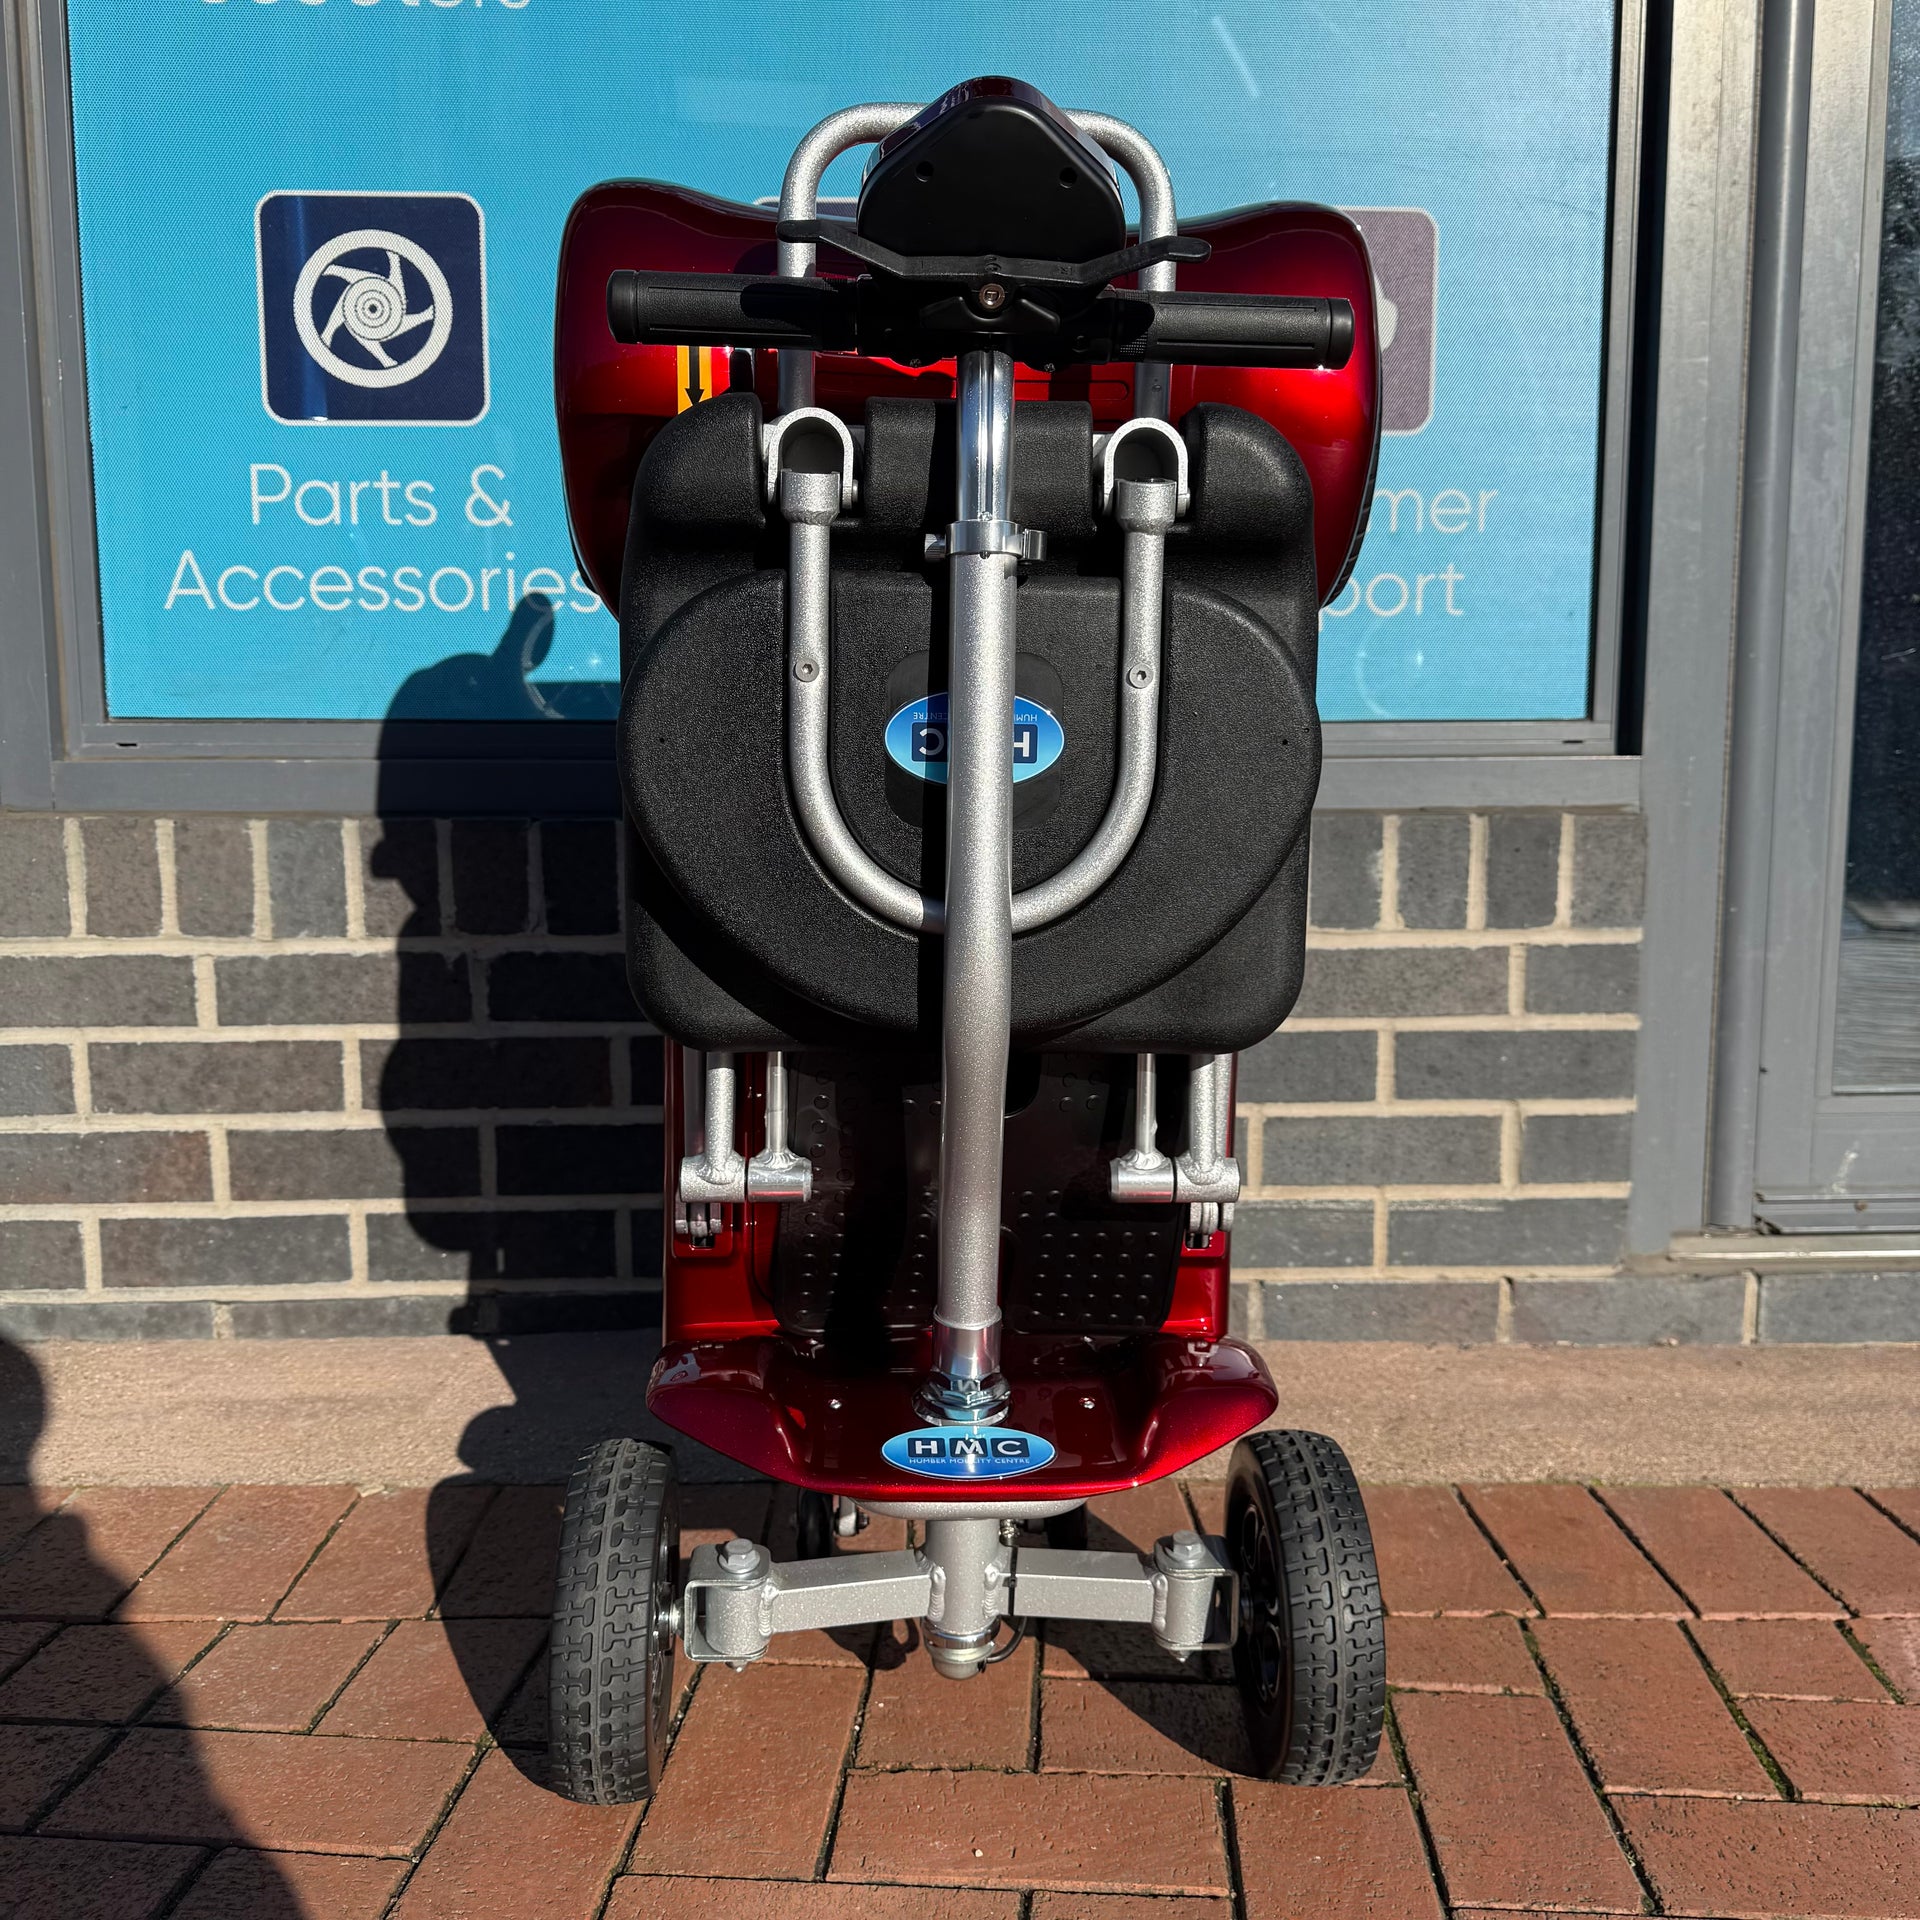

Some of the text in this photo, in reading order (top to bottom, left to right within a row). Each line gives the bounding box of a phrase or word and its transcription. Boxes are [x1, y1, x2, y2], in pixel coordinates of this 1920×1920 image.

[250, 464, 514, 527] Parts &
[1366, 488, 1499, 533] mer
[164, 549, 602, 613] Accessories
[1318, 563, 1465, 632] port
[1014, 714, 1038, 722] HUM
[919, 728, 1030, 758] HC
[915, 1440, 1022, 1455] HMC
